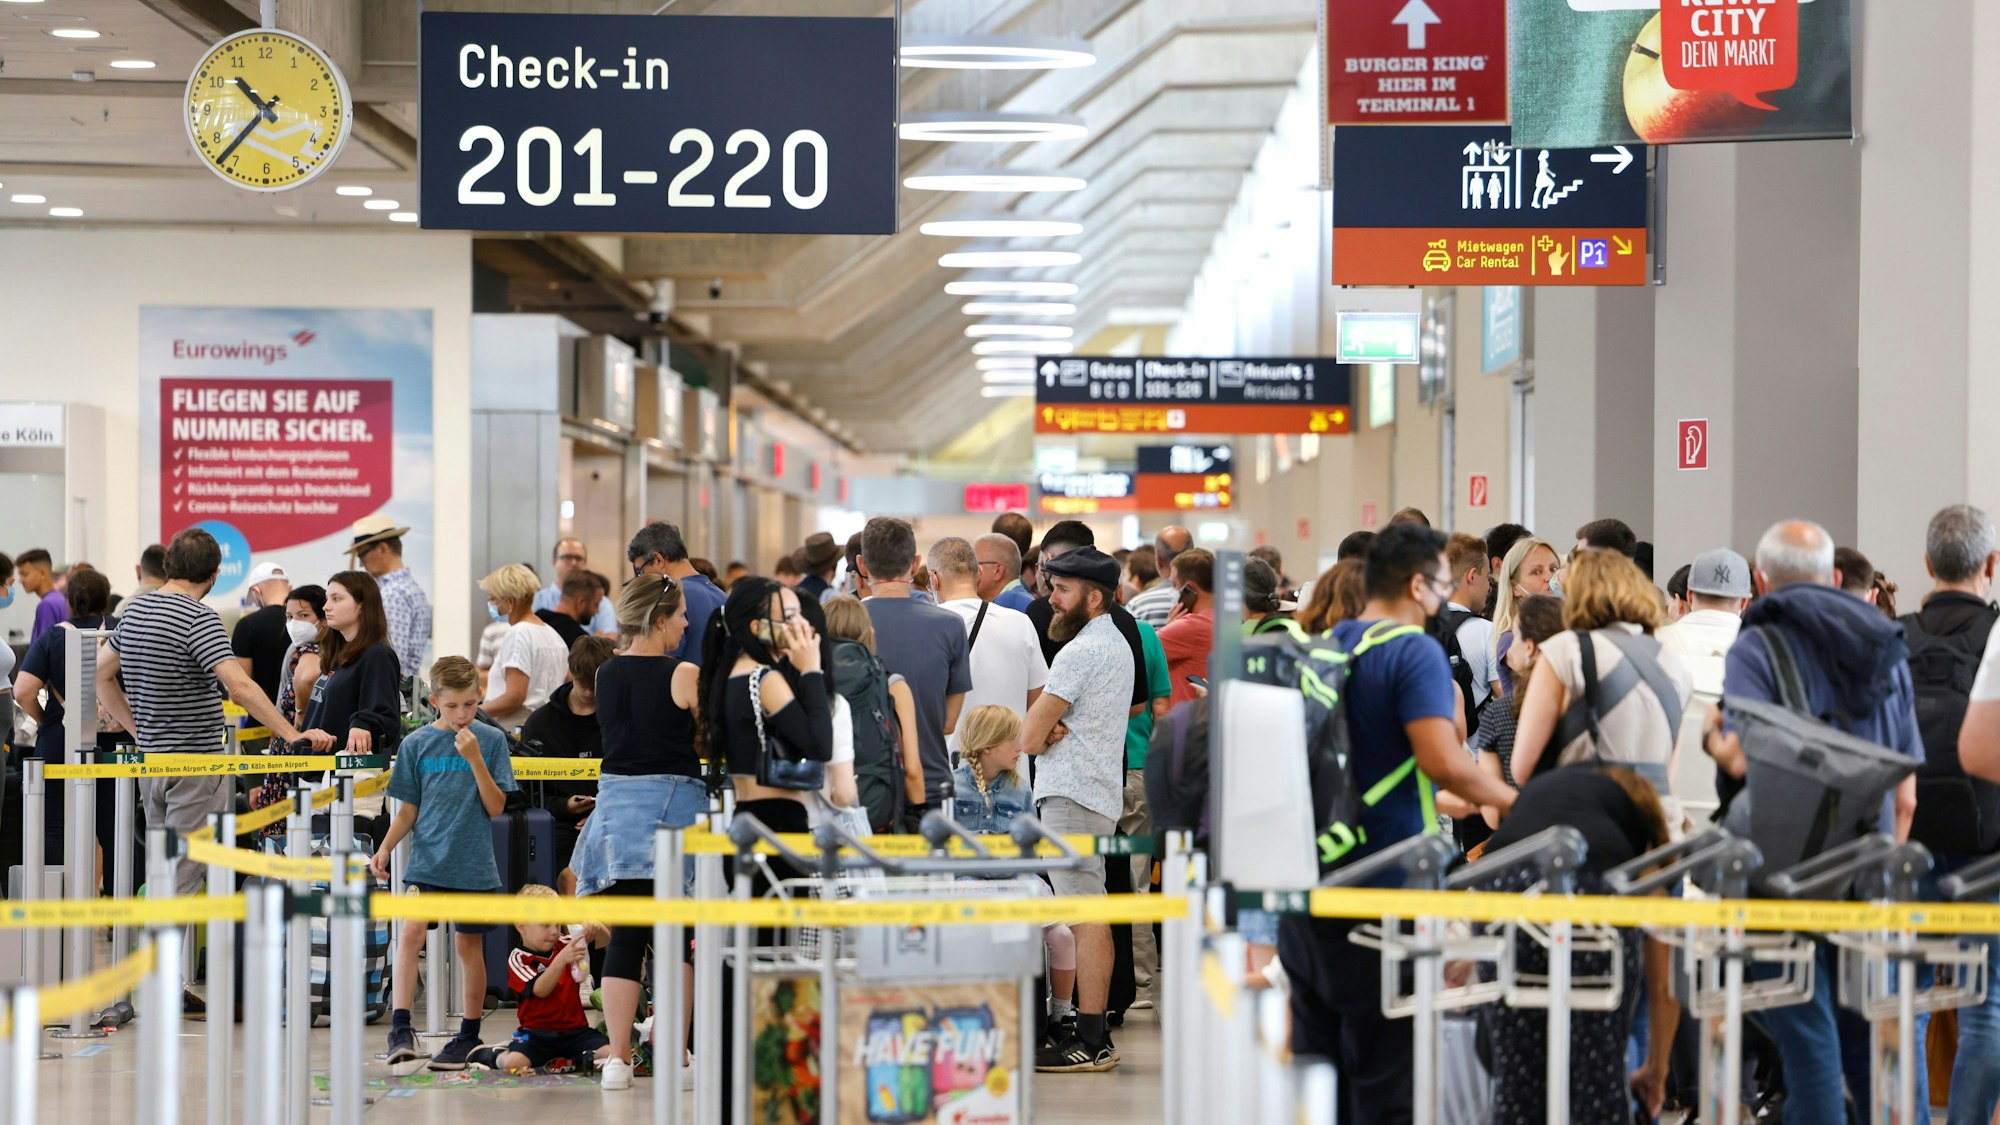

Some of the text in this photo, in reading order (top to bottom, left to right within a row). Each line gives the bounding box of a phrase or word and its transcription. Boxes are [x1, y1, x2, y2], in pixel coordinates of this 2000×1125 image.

[1691, 8, 1766, 37] CITY
[258, 47, 273, 59] 12
[1681, 38, 1777, 68] DEIN MARKT
[230, 56, 245, 68] 11
[290, 57, 298, 68] 1
[459, 43, 669, 91] Check-in
[1345, 57, 1428, 73] BURGER
[209, 76, 224, 88] 10
[310, 79, 318, 91] 2
[1378, 76, 1456, 93] HIER IM
[203, 104, 211, 116] 9
[320, 106, 327, 118] 3
[1357, 97, 1475, 113] TERMINAL 1
[213, 132, 221, 144] 8
[309, 133, 317, 144] 4
[232, 155, 240, 167] 7
[292, 156, 300, 168] 5
[458, 125, 829, 210] 201-220
[263, 163, 271, 175] 6
[1457, 240, 1524, 253] Mietwagen
[1456, 256, 1519, 268] Car Rental
[173, 340, 288, 365] Eurowings
[1144, 360, 1209, 380] Check-in
[1244, 362, 1303, 381] Ankunft
[172, 388, 360, 413] FLIEGEN SIE AUF
[16, 427, 53, 442] Köln
[172, 418, 373, 442] NUMMER SICHER.
[188, 446, 350, 465] Flexible Umbuchungsoptionen
[188, 463, 359, 480] Informiert mit dem Reiseberater
[188, 481, 371, 499] Rückholgarantie nach Deutschland
[188, 499, 339, 515] Corona-Reiseschutz buchbar
[1713, 565, 1730, 584] NY
[183, 765, 207, 773] Airport
[285, 761, 309, 769] Airport
[543, 769, 568, 777] Airport
[854, 1027, 1006, 1066] HAVE FUN!
